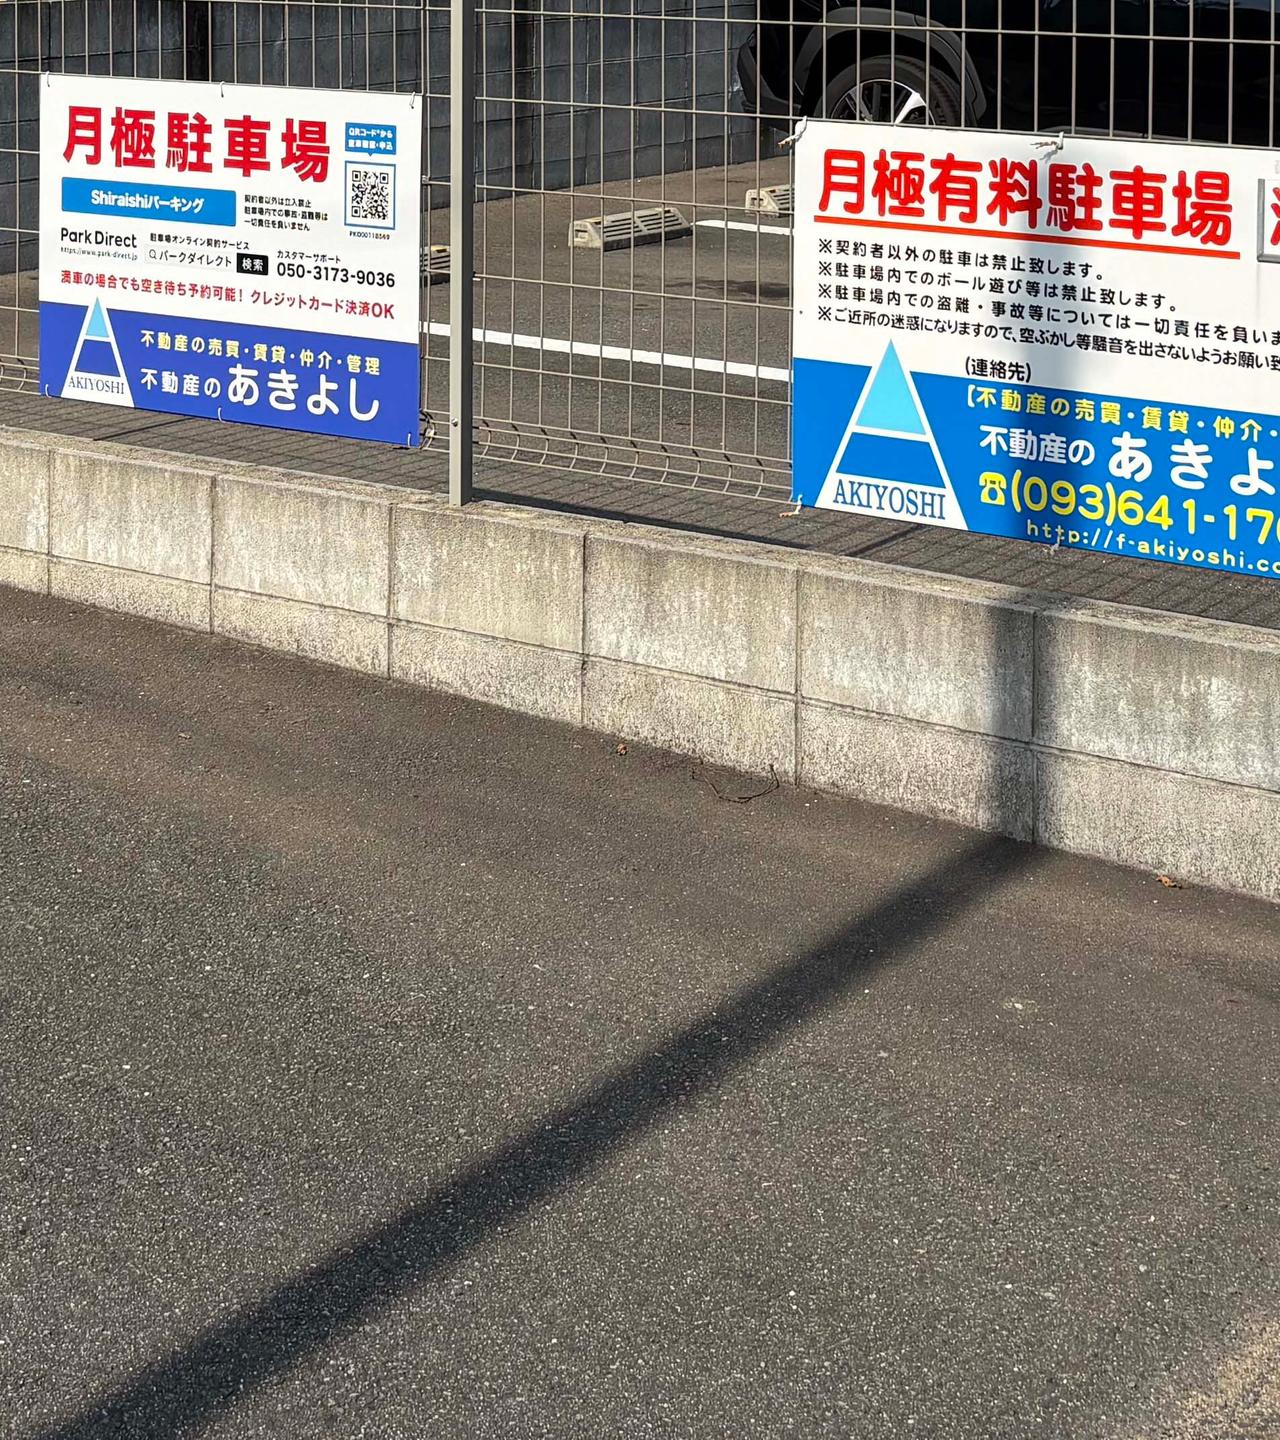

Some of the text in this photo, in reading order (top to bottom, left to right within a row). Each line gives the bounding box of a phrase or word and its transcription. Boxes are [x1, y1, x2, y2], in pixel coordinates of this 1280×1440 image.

[63, 105, 330, 183] 月極駐車場
[91, 189, 205, 214] Shiraishiパーキング
[819, 148, 1232, 247] 月極有料駐車場
[60, 227, 137, 248] Park Direct
[159, 249, 264, 272] パークダイレクト 検索
[277, 250, 341, 264] カスタマーサポート
[818, 238, 1103, 280] ※契約者以外の駐車は禁止致します。
[277, 262, 395, 288] 050-3173-9036
[140, 329, 380, 376] 不動産の売買・賃貸・仲介・管理
[965, 356, 1032, 383] (連絡先)
[67, 375, 125, 395] AKIYOSHI
[833, 478, 946, 520] AKIYOSHI
